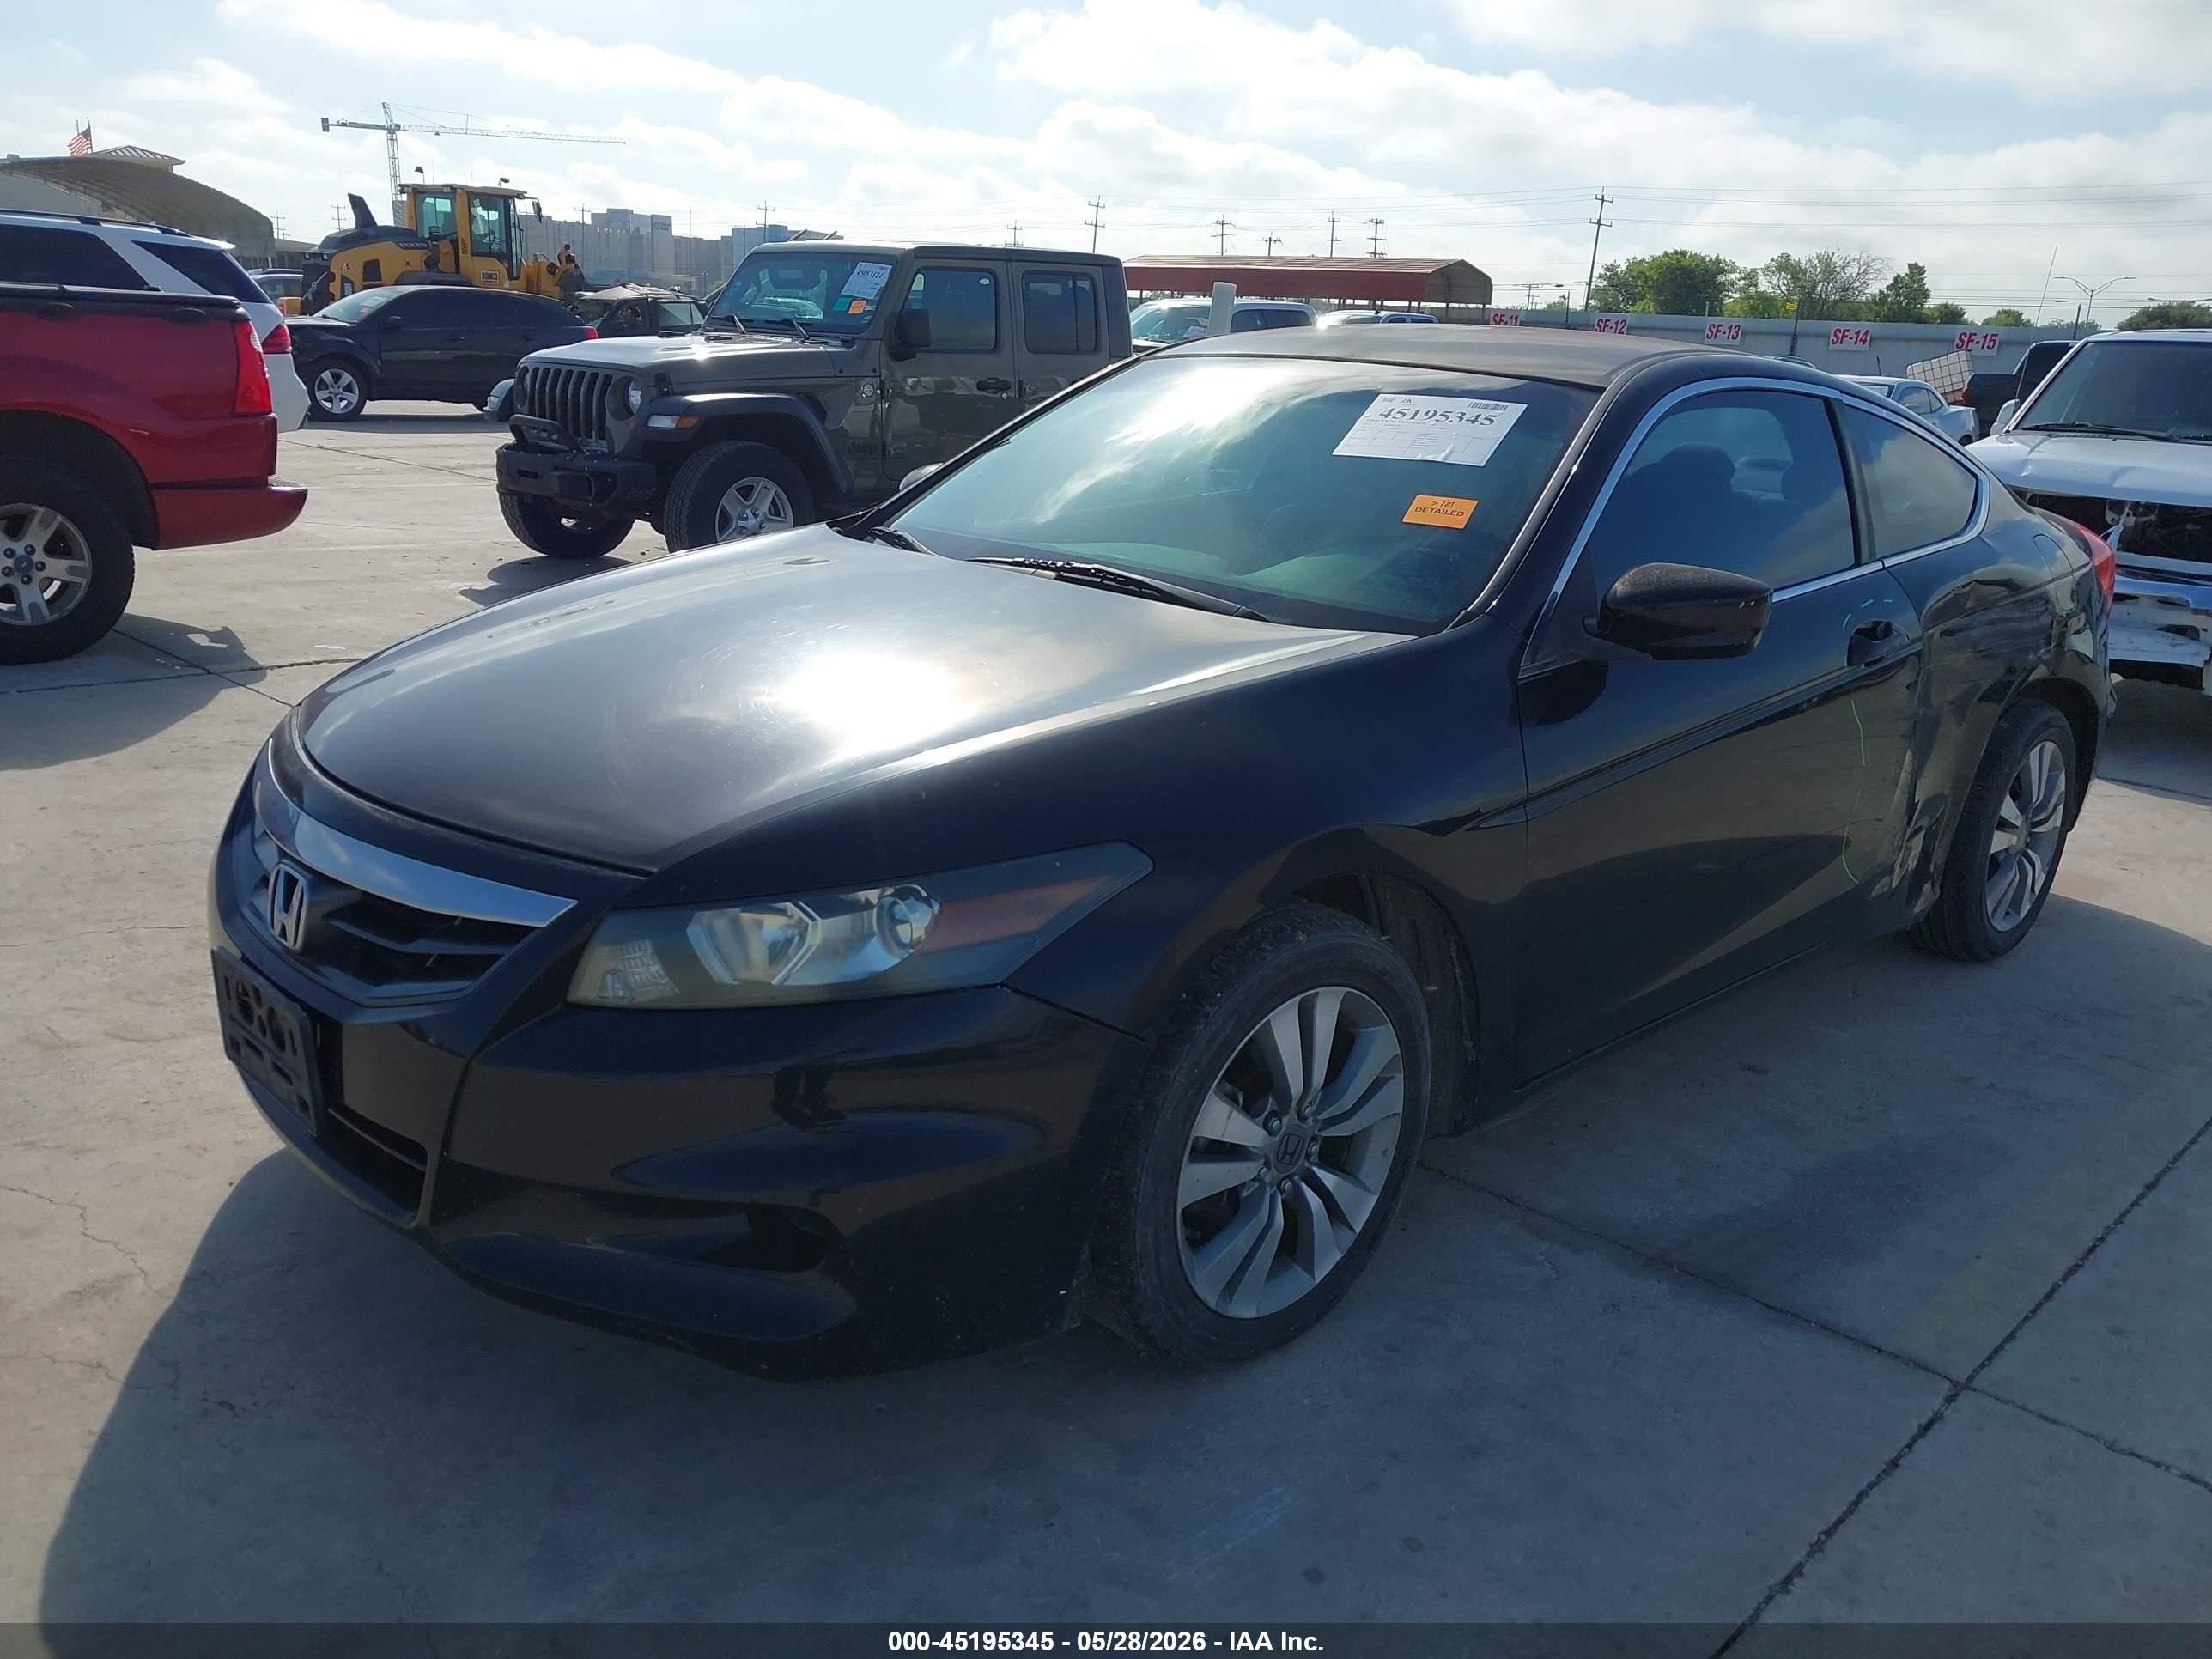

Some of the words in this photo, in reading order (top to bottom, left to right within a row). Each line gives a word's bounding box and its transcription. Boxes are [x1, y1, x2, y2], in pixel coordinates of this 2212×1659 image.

[1492, 313, 1519, 326] SF-11
[1595, 319, 1627, 334] SF-12
[1706, 323, 1741, 340] SF-13
[1831, 328, 1869, 345] SF-14
[1955, 332, 1999, 350] SF-15
[1379, 407, 1498, 426] 45195345
[1414, 506, 1465, 517] DETAILED
